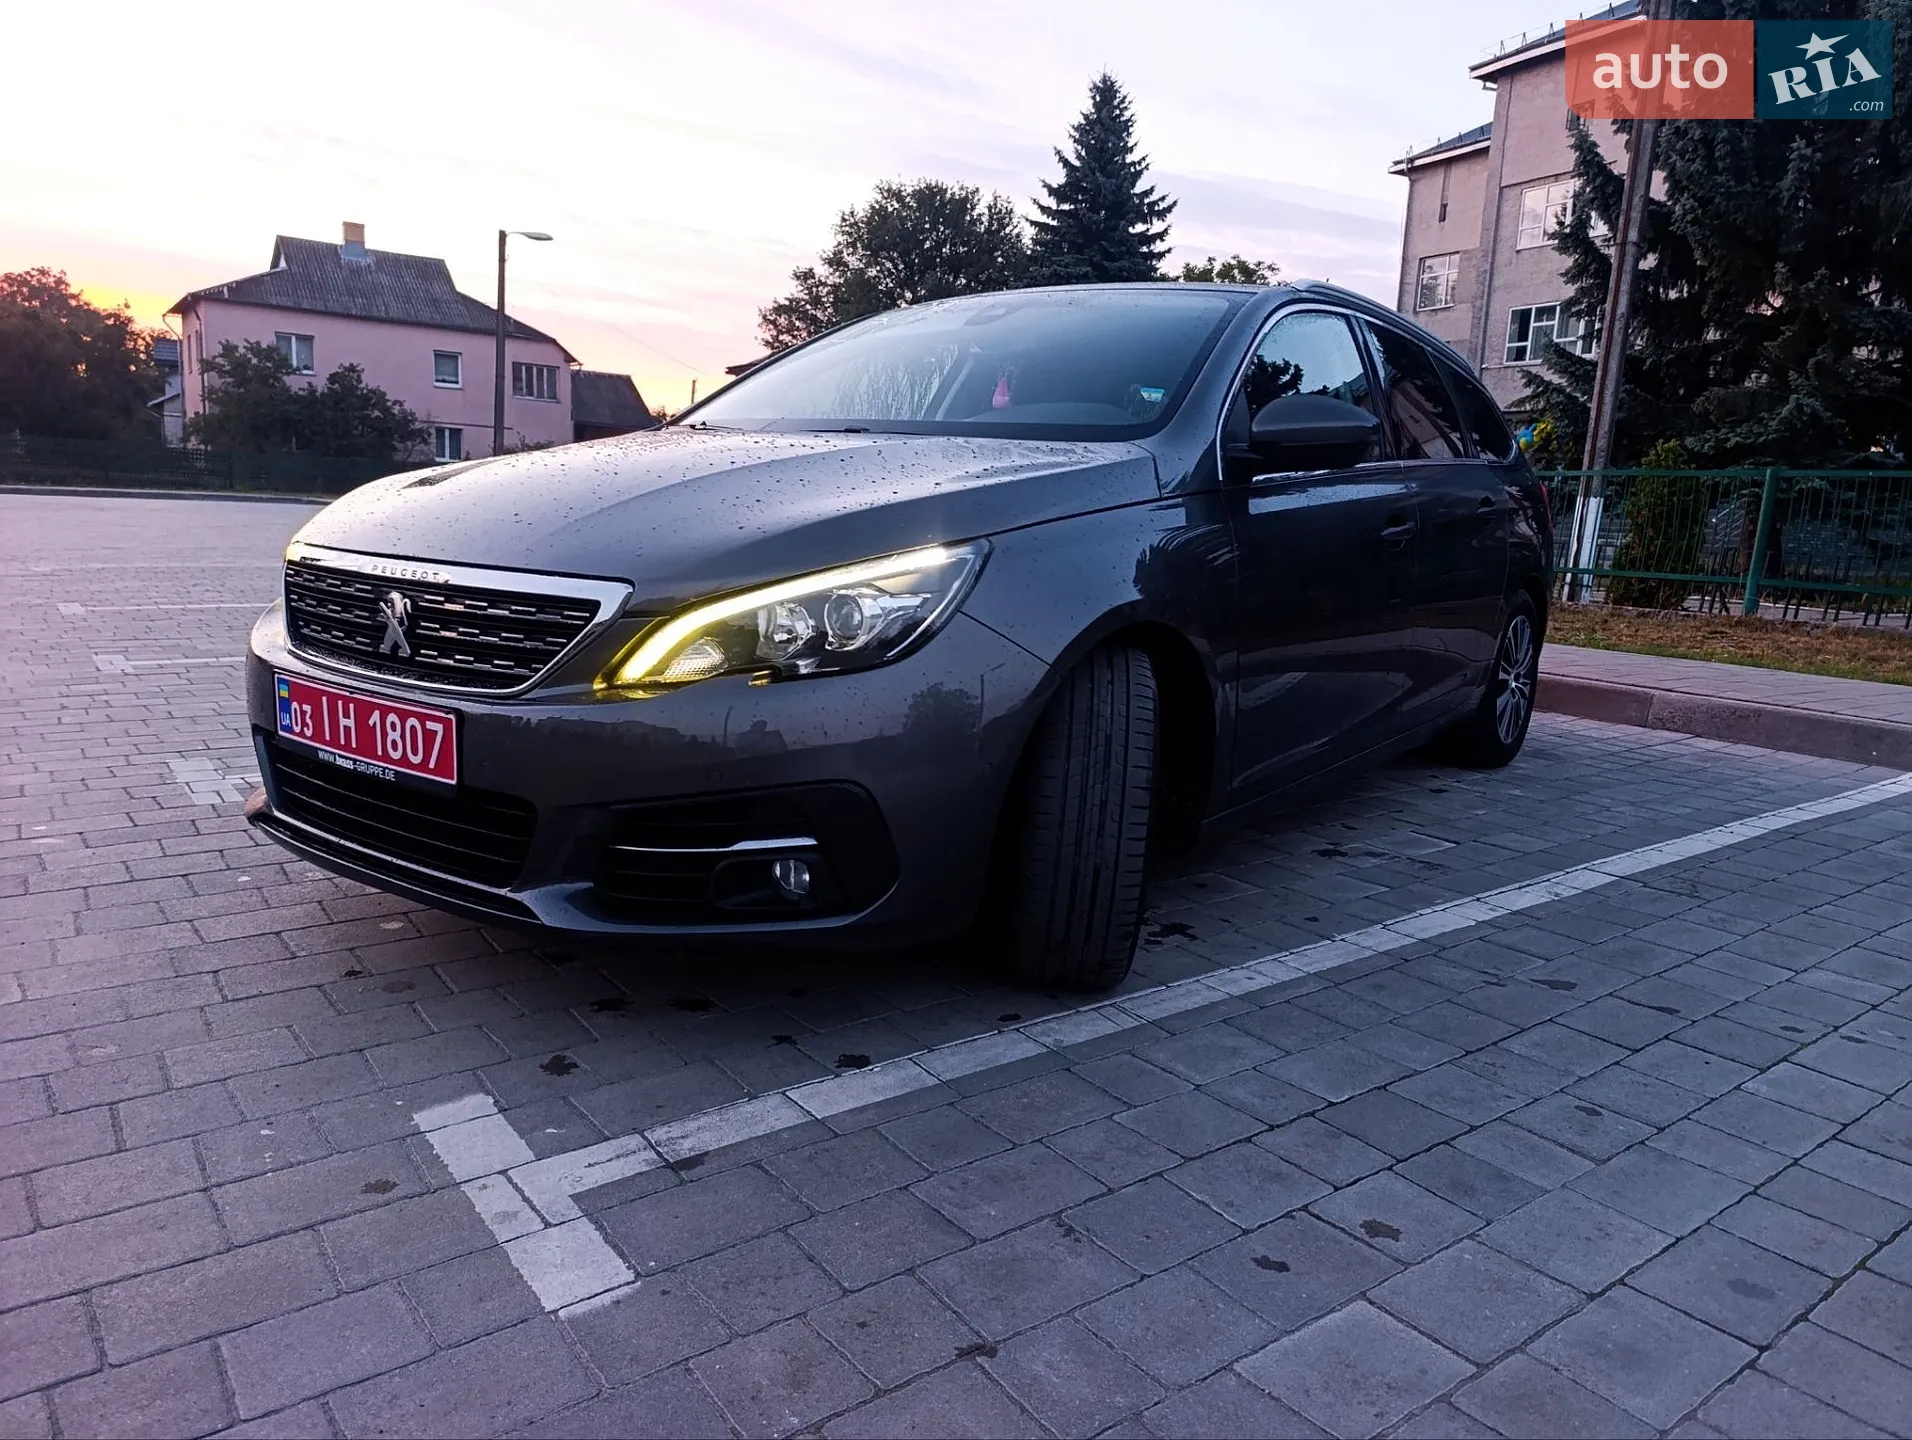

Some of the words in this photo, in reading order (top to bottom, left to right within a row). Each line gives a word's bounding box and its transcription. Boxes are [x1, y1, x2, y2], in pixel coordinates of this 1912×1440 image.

[371, 564, 439, 580] PEUGEOT
[280, 711, 292, 727] UA
[291, 701, 313, 738] 03
[368, 709, 444, 769] 1807
